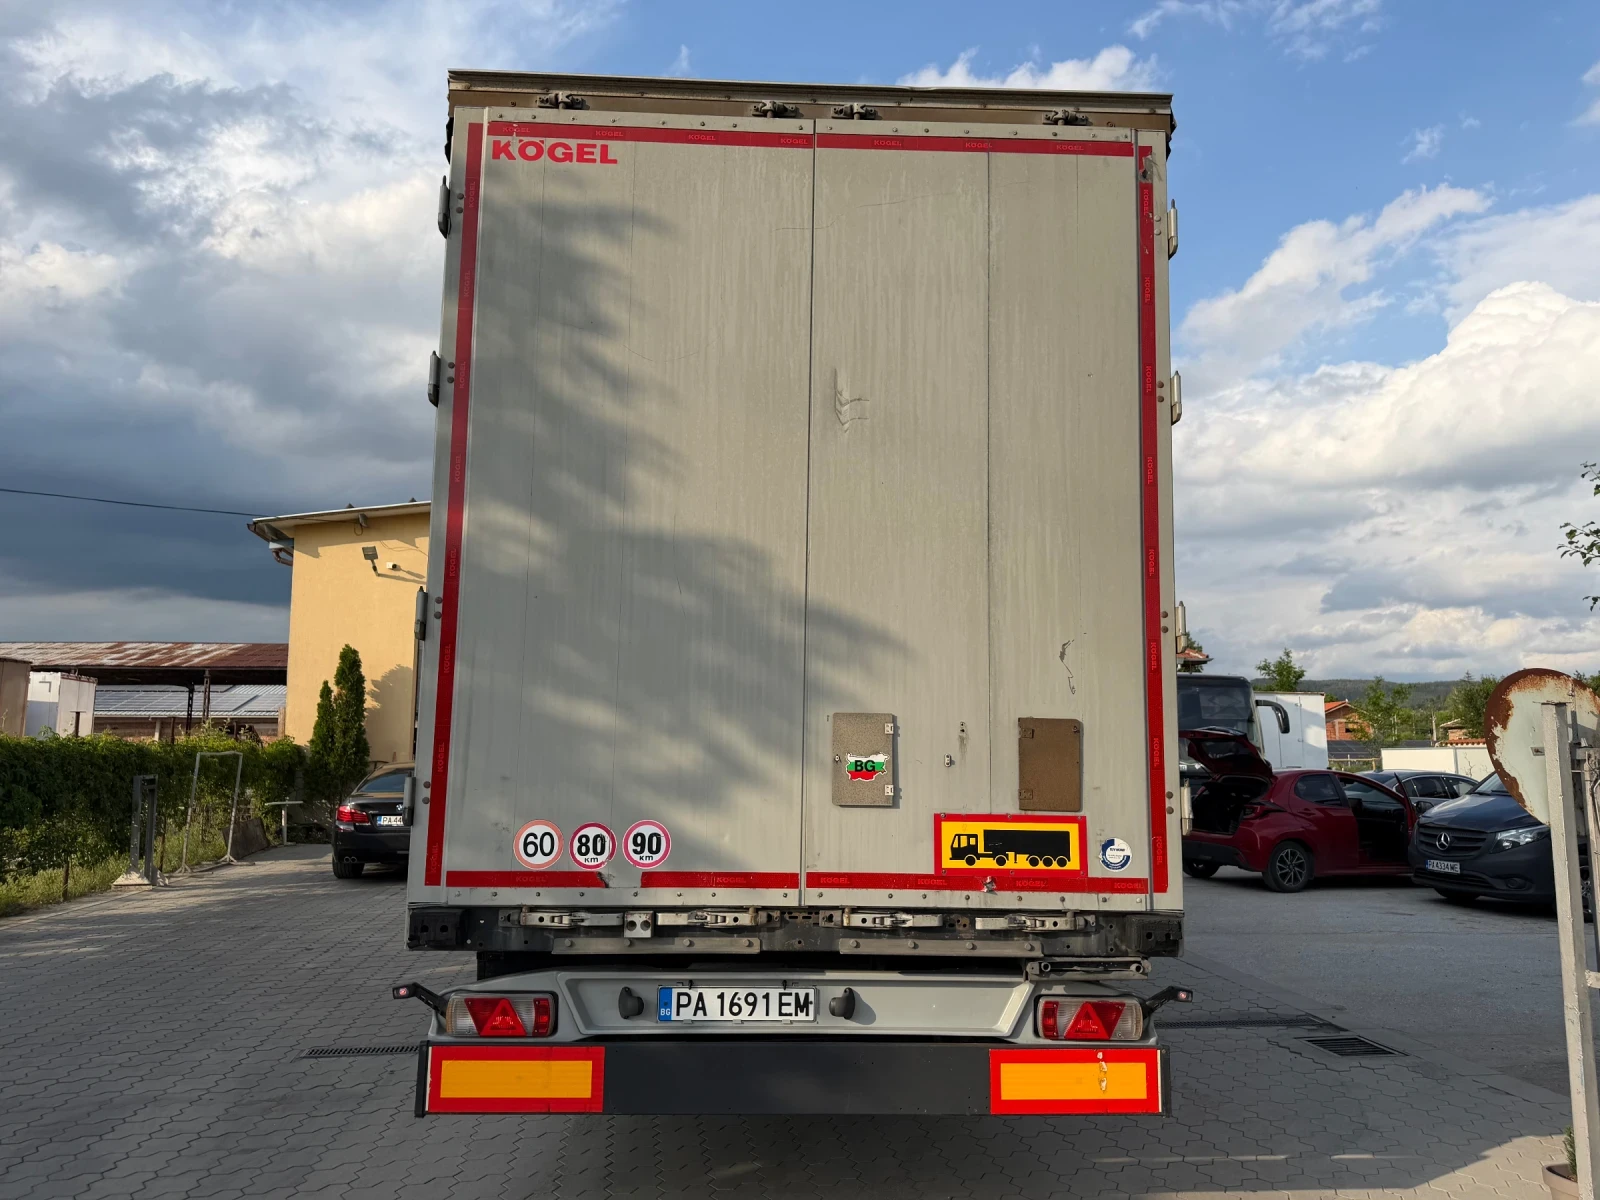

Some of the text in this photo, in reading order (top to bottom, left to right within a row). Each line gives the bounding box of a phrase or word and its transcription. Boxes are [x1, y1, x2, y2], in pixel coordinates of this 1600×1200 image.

[491, 139, 618, 165] KÖGEL
[854, 760, 876, 772] BG
[523, 831, 555, 858] 60
[577, 834, 606, 857] 80
[632, 832, 662, 855] 90
[660, 1008, 671, 1016] BG
[676, 992, 810, 1017] PA 1691 EM
